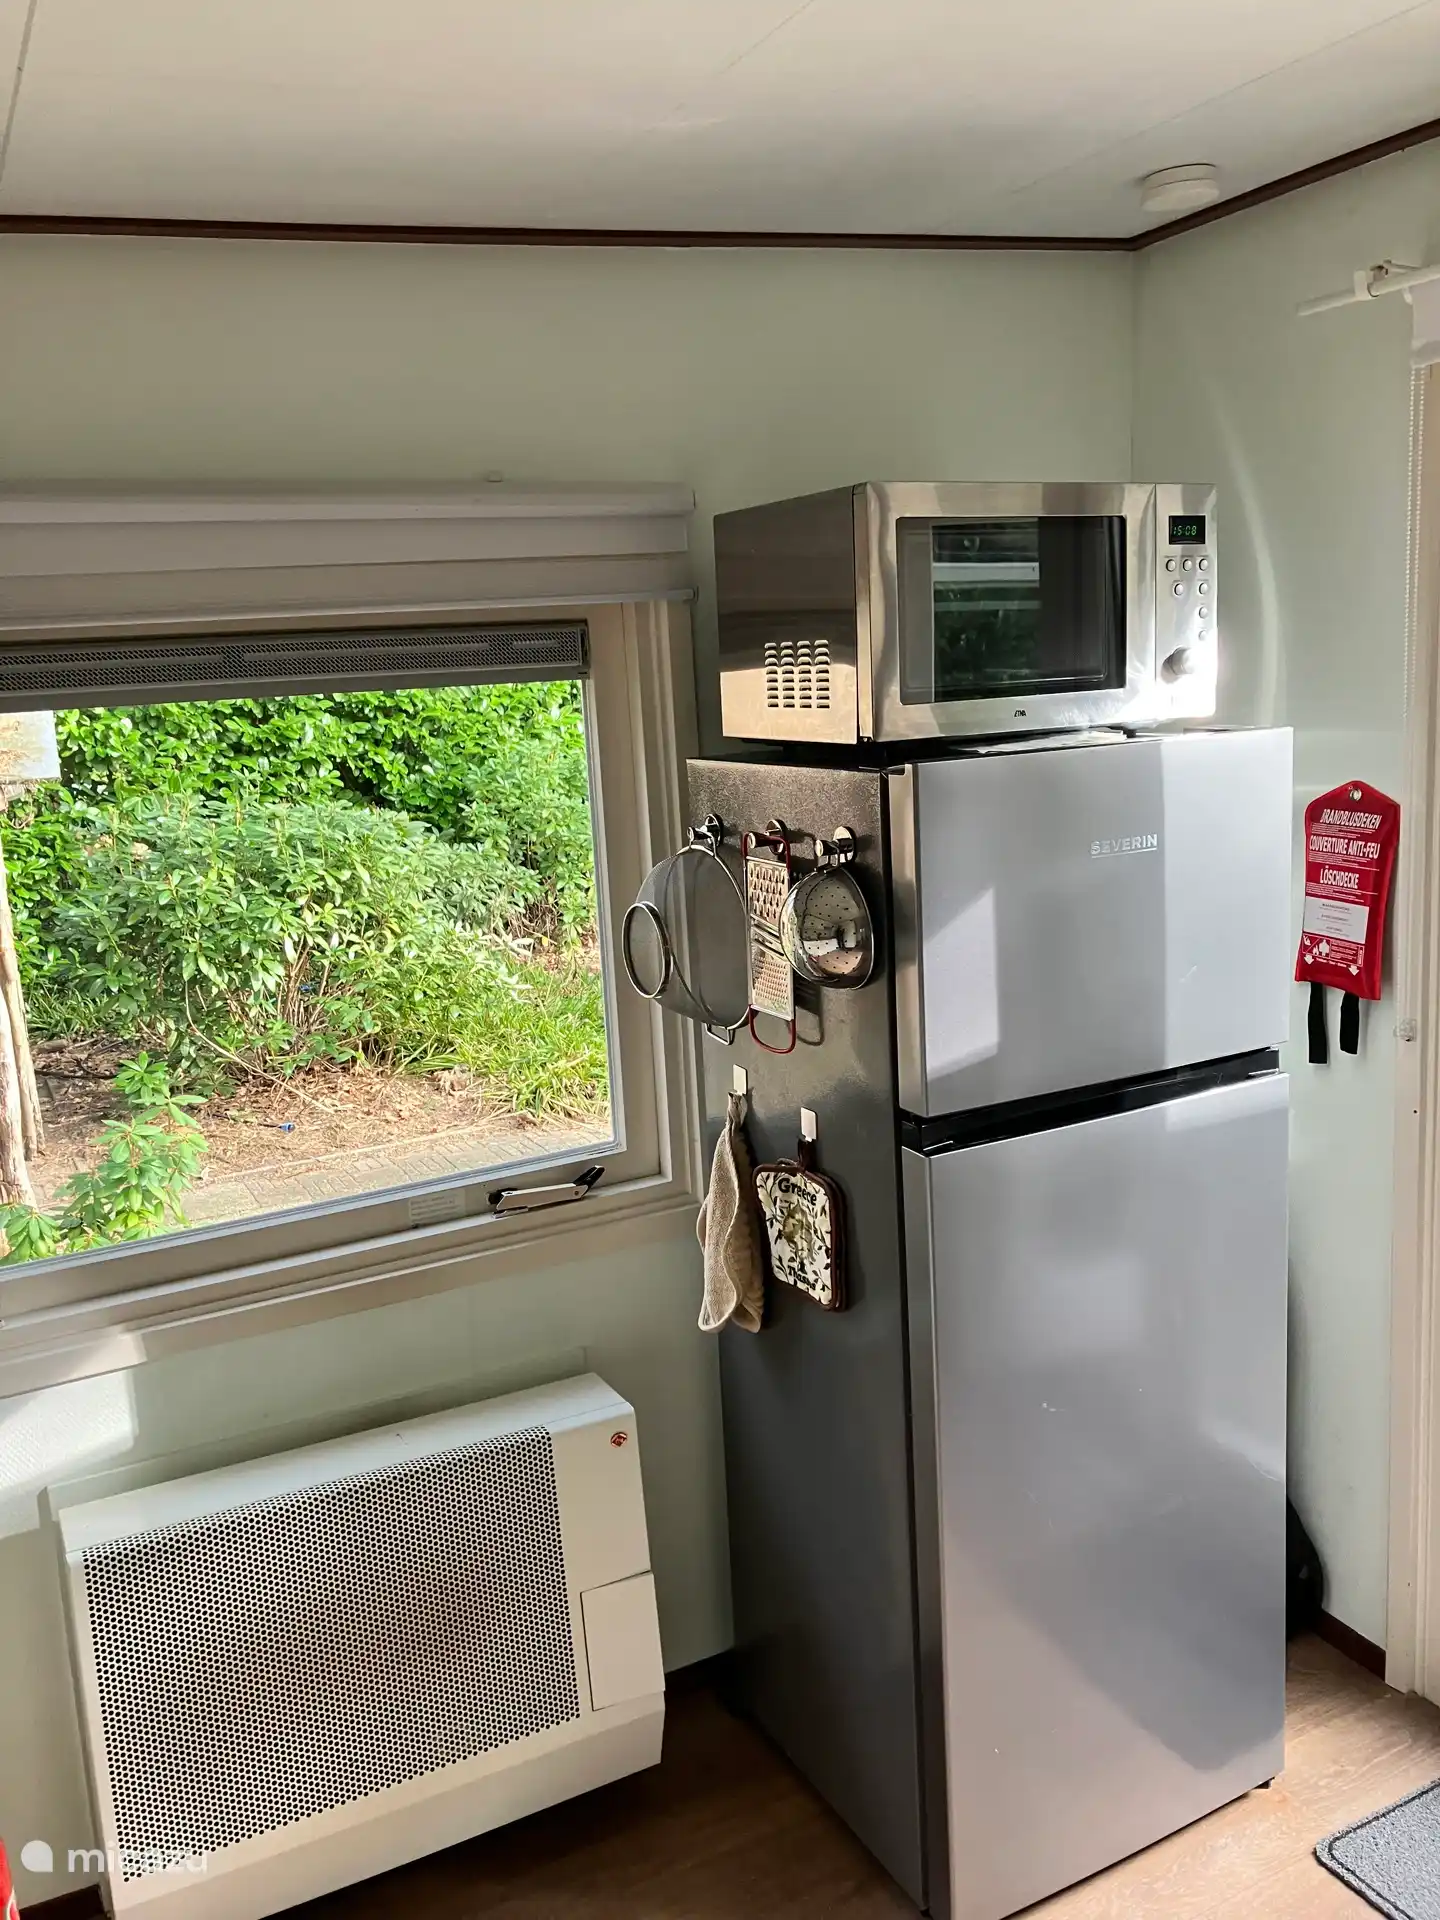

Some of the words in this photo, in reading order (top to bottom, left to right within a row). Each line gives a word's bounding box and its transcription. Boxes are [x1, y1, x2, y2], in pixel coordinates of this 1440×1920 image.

[1090, 833, 1158, 855] SEVERIN
[1309, 834, 1348, 854] COUVERTURE
[1347, 839, 1380, 859] ANTI-FEU
[1319, 865, 1360, 889] LÖSCHDECKE
[777, 1177, 817, 1206] Greece
